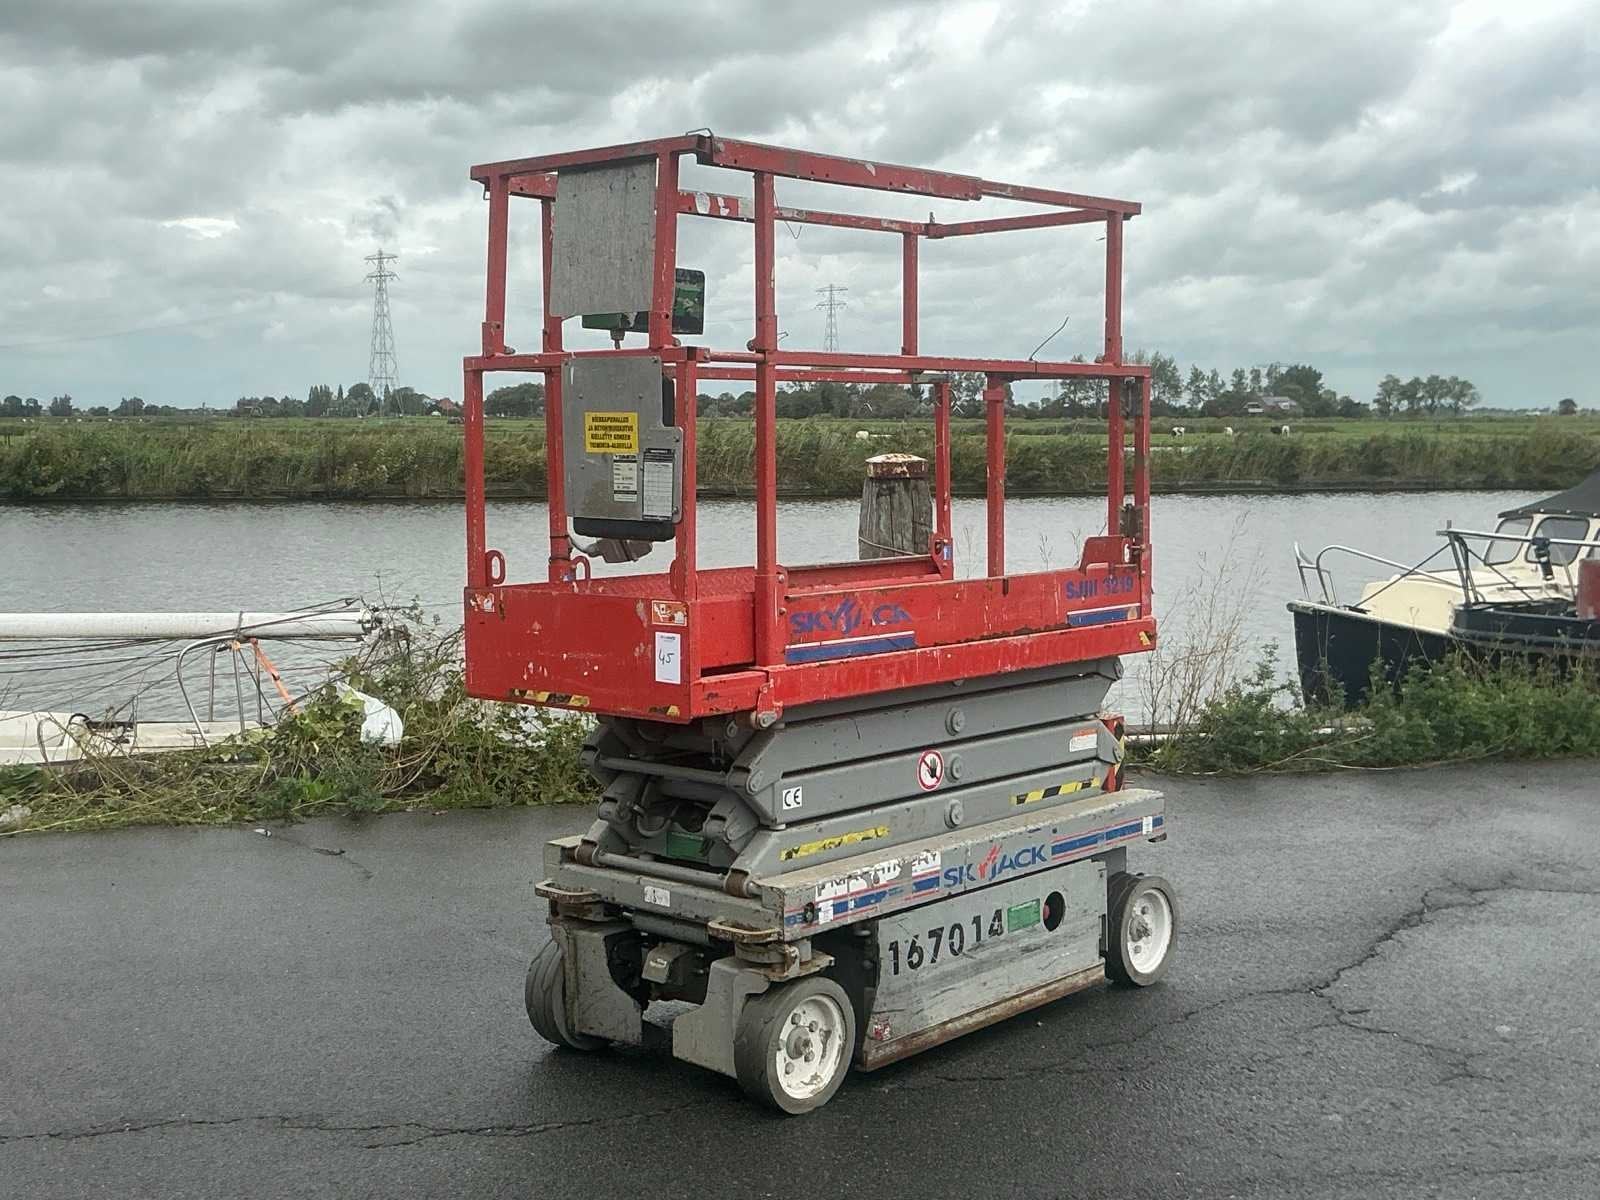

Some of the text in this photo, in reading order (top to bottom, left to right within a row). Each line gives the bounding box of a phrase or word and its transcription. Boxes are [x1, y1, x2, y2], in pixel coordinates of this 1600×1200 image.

[790, 597, 912, 635] SKYJCK
[658, 647, 675, 665] 45
[784, 788, 801, 807] CE
[943, 843, 1048, 889] SKYJACK
[888, 908, 1004, 976] 167014
